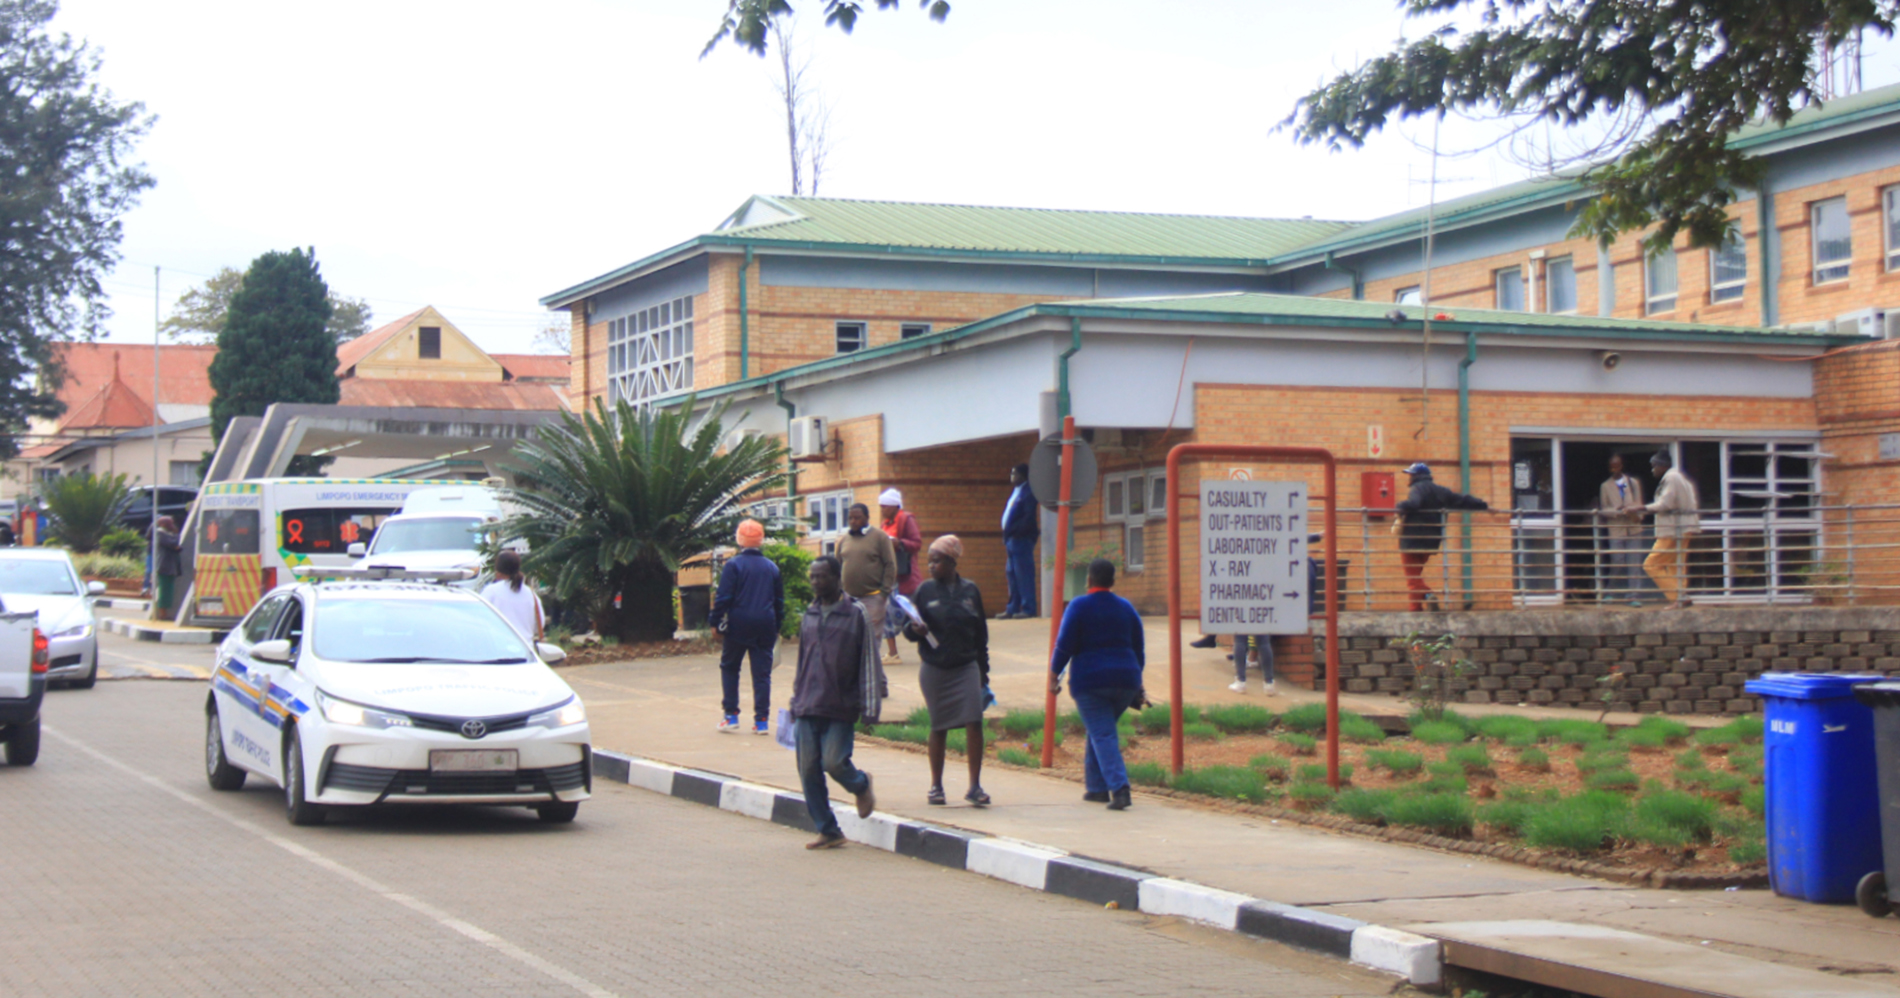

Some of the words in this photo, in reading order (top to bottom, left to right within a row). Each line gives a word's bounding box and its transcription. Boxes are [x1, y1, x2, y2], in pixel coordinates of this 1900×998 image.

[316, 491, 351, 501] LIMPOPO
[353, 491, 399, 501] EMERGENCY
[1207, 490, 1267, 508] CASUALTY
[1208, 513, 1283, 531] OUT-PATIENTS
[1208, 537, 1278, 555] LABORATORY
[1209, 583, 1275, 601] PHARMACY
[1249, 606, 1278, 624] DEPT.
